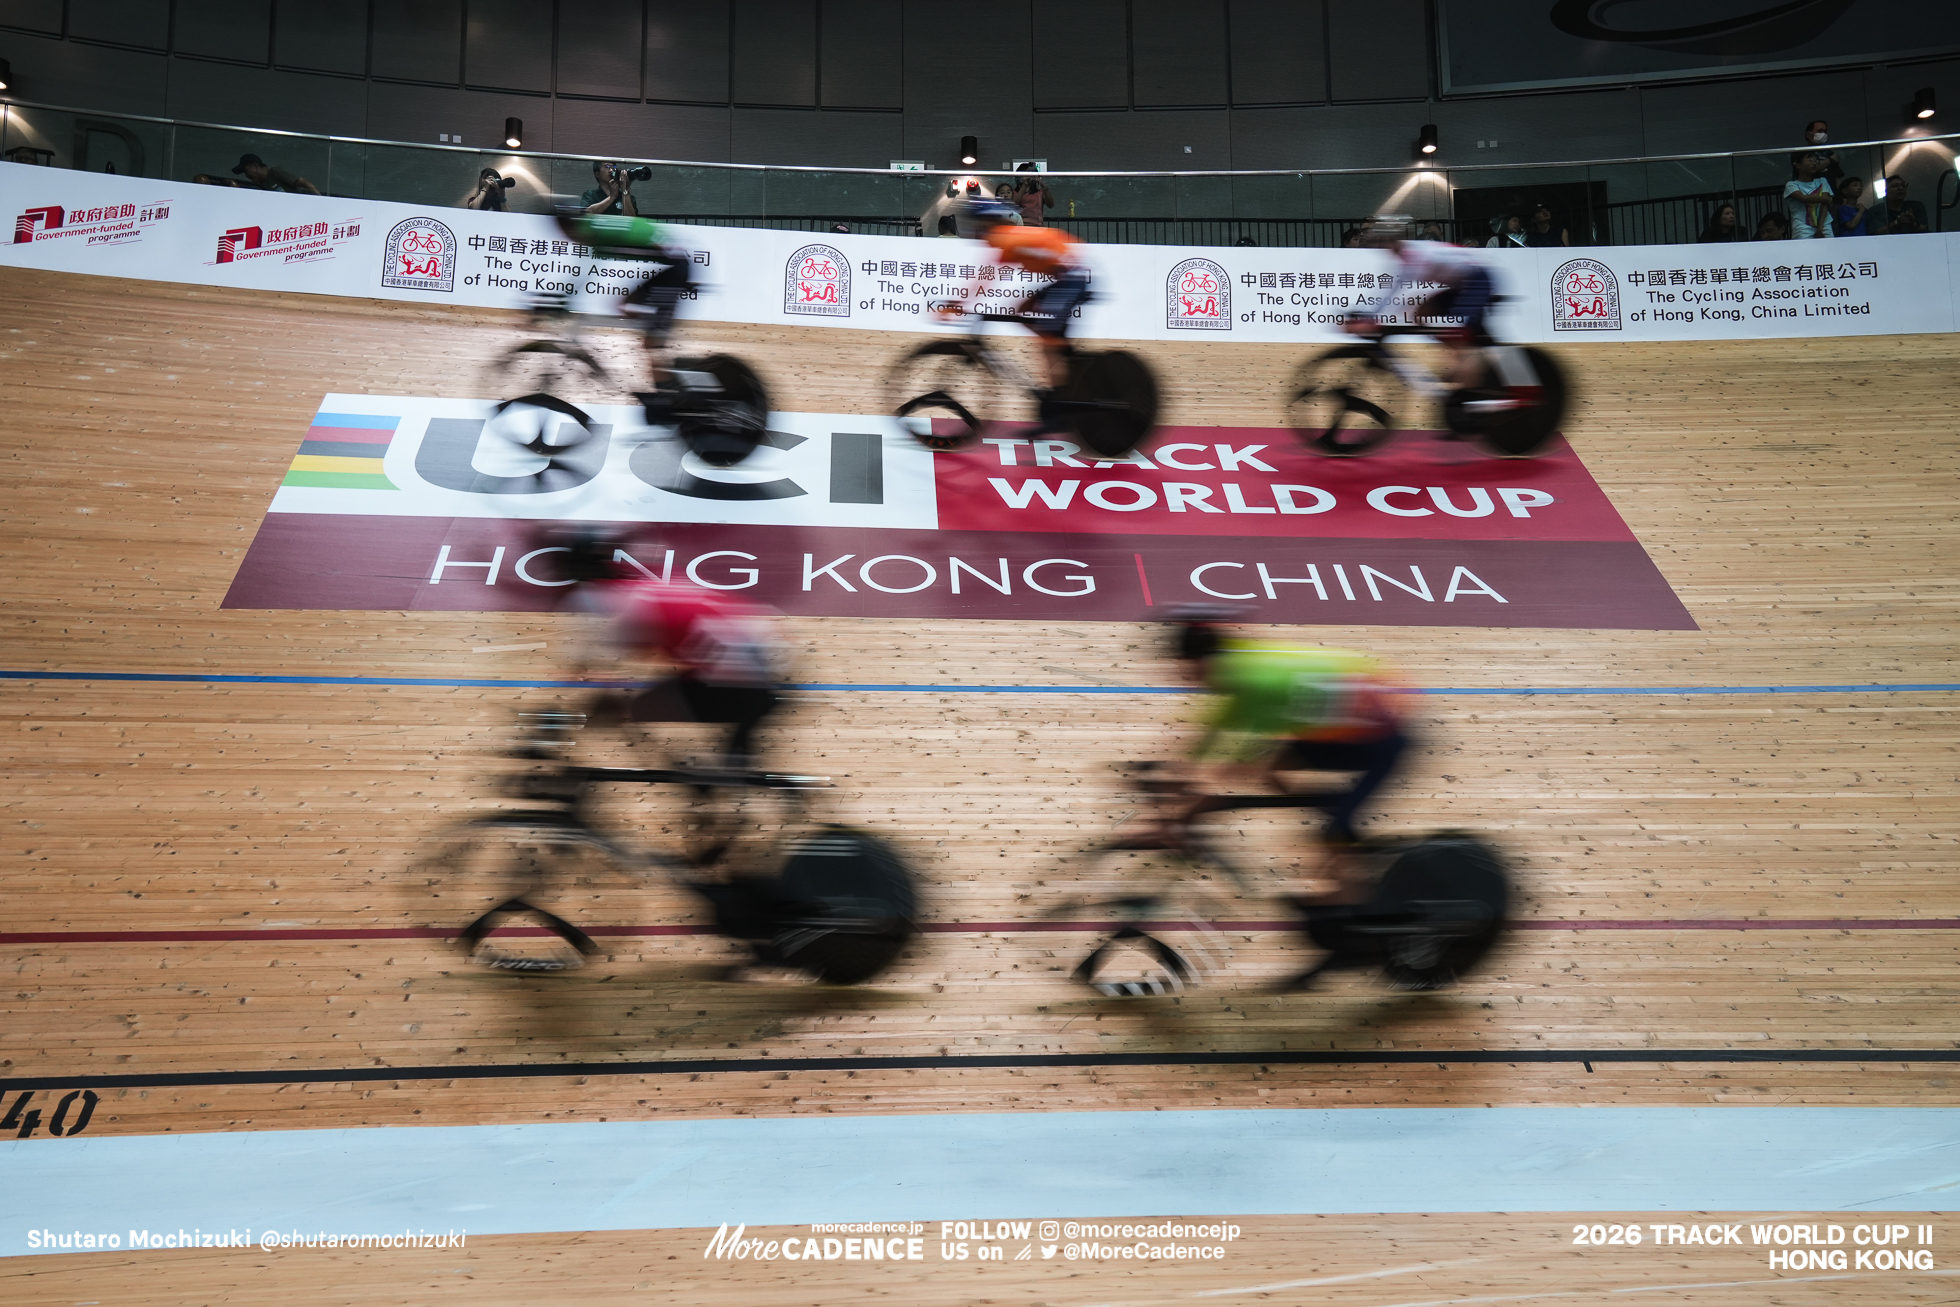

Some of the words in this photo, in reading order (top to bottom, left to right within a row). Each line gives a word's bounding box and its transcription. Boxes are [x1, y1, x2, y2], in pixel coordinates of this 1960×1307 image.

[69, 203, 136, 224] 政府資助
[140, 207, 170, 222] 計劃
[35, 221, 133, 241] Government-funded
[88, 229, 140, 244] programme
[267, 222, 328, 244] 政府資助
[332, 224, 360, 240] 計劃
[390, 220, 422, 242] ASSOCIATION
[236, 239, 327, 260] Government-funded
[285, 247, 334, 262] programme
[790, 247, 818, 270] ASSOCIATION
[484, 256, 512, 269] The
[520, 259, 581, 276] Cycling
[1170, 261, 1197, 284] ASSOCIATION
[1555, 261, 1581, 286] ASSOCIATION
[1591, 263, 1608, 276] HONG
[1628, 262, 1878, 286] 中國香港單車總會有限公司
[464, 274, 481, 285] of
[488, 274, 528, 291] Hong
[536, 278, 578, 295] Kong,
[586, 282, 629, 296] China
[877, 280, 904, 293] The
[911, 282, 969, 298] Cycling
[1646, 291, 1675, 303] The
[1682, 289, 1744, 304] Cycling
[1752, 285, 1849, 300] Association
[860, 298, 875, 310] of
[882, 299, 920, 314] Hong
[974, 303, 1016, 315] China
[1257, 293, 1284, 305] The
[1291, 293, 1348, 307] Cycling
[1356, 294, 1427, 306] Associati
[1554, 286, 1562, 308] CYCLING
[1241, 311, 1256, 322] of
[1263, 311, 1300, 325] Hong
[1631, 309, 1646, 321] of
[1654, 309, 1693, 322] Hong
[1701, 307, 1744, 321] Kong,
[1752, 305, 1797, 318] China
[1805, 302, 1870, 316] Limited
[415, 417, 883, 504] UCI
[987, 478, 1337, 514] WORLD
[1366, 486, 1555, 518] CUP
[802, 553, 1096, 598] KONG
[1189, 561, 1509, 604] CHINA
[0, 1090, 98, 1138] 40
